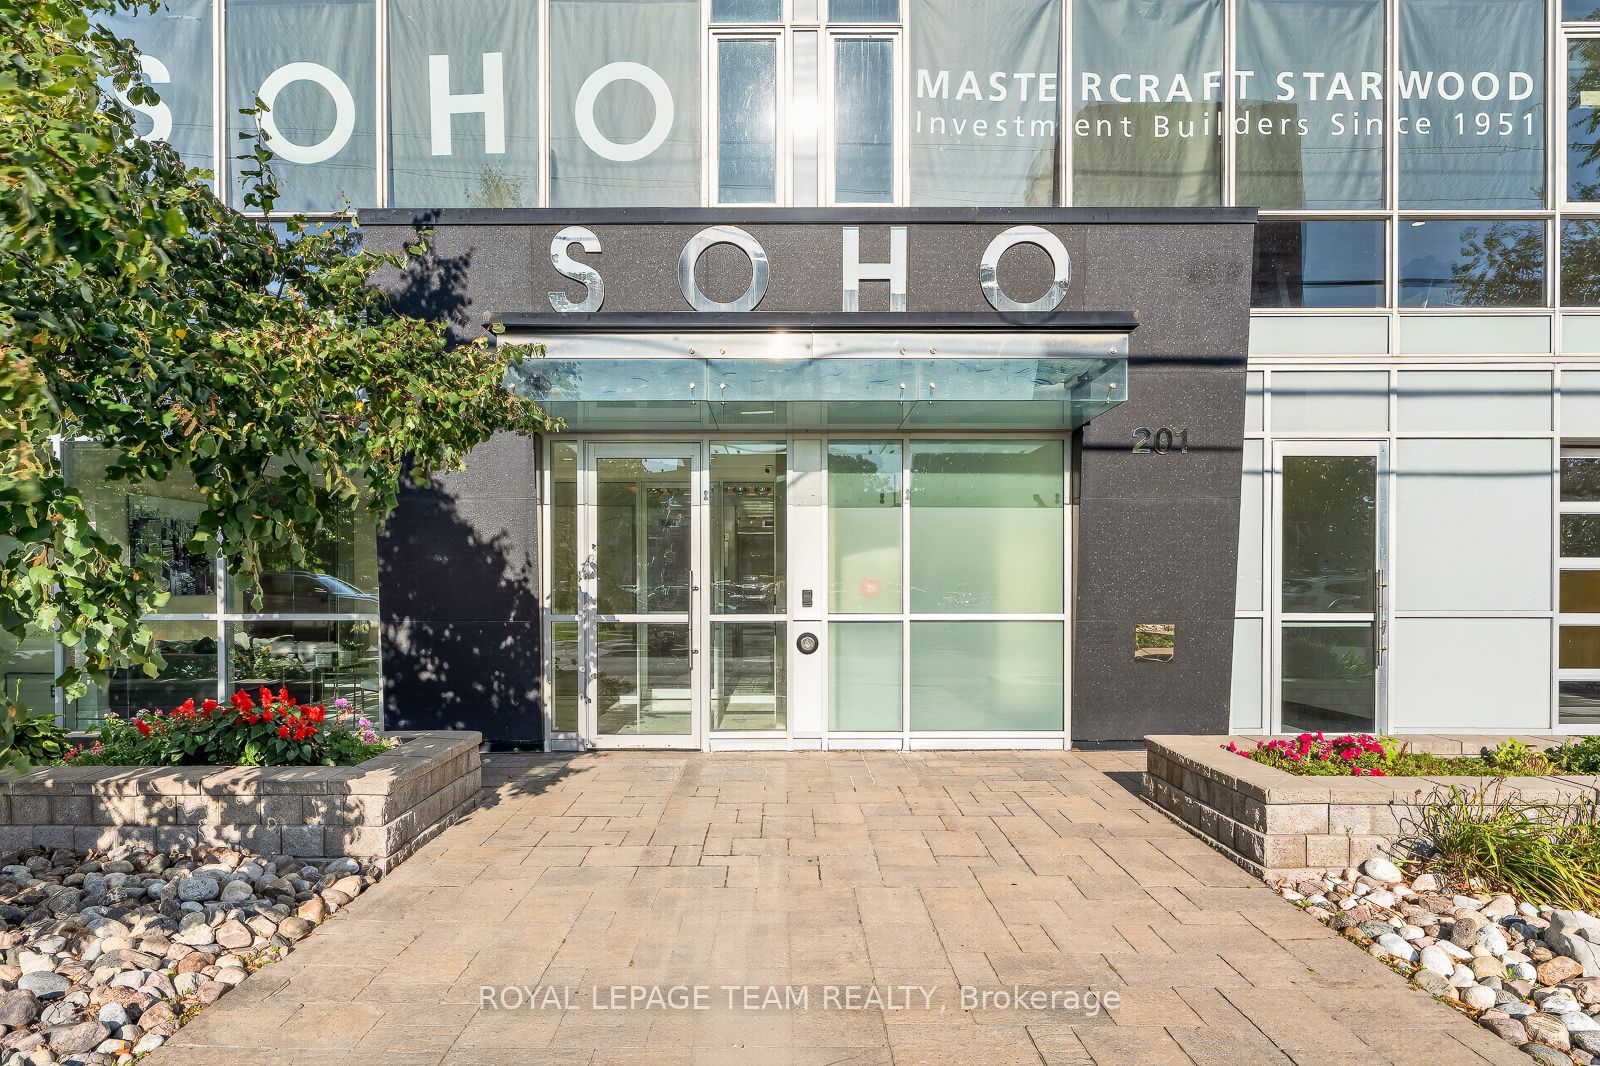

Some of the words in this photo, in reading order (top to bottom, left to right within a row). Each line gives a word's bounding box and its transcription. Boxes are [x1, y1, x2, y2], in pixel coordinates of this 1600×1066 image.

[1276, 70, 1534, 102] STARWOOD
[113, 52, 675, 164] SOHO
[916, 110, 1132, 137] Investment
[1154, 111, 1309, 138] Builders
[1331, 112, 1431, 135] Since
[1454, 112, 1532, 135] 1951
[547, 225, 1071, 312] SOHO
[1131, 426, 1189, 455] 201
